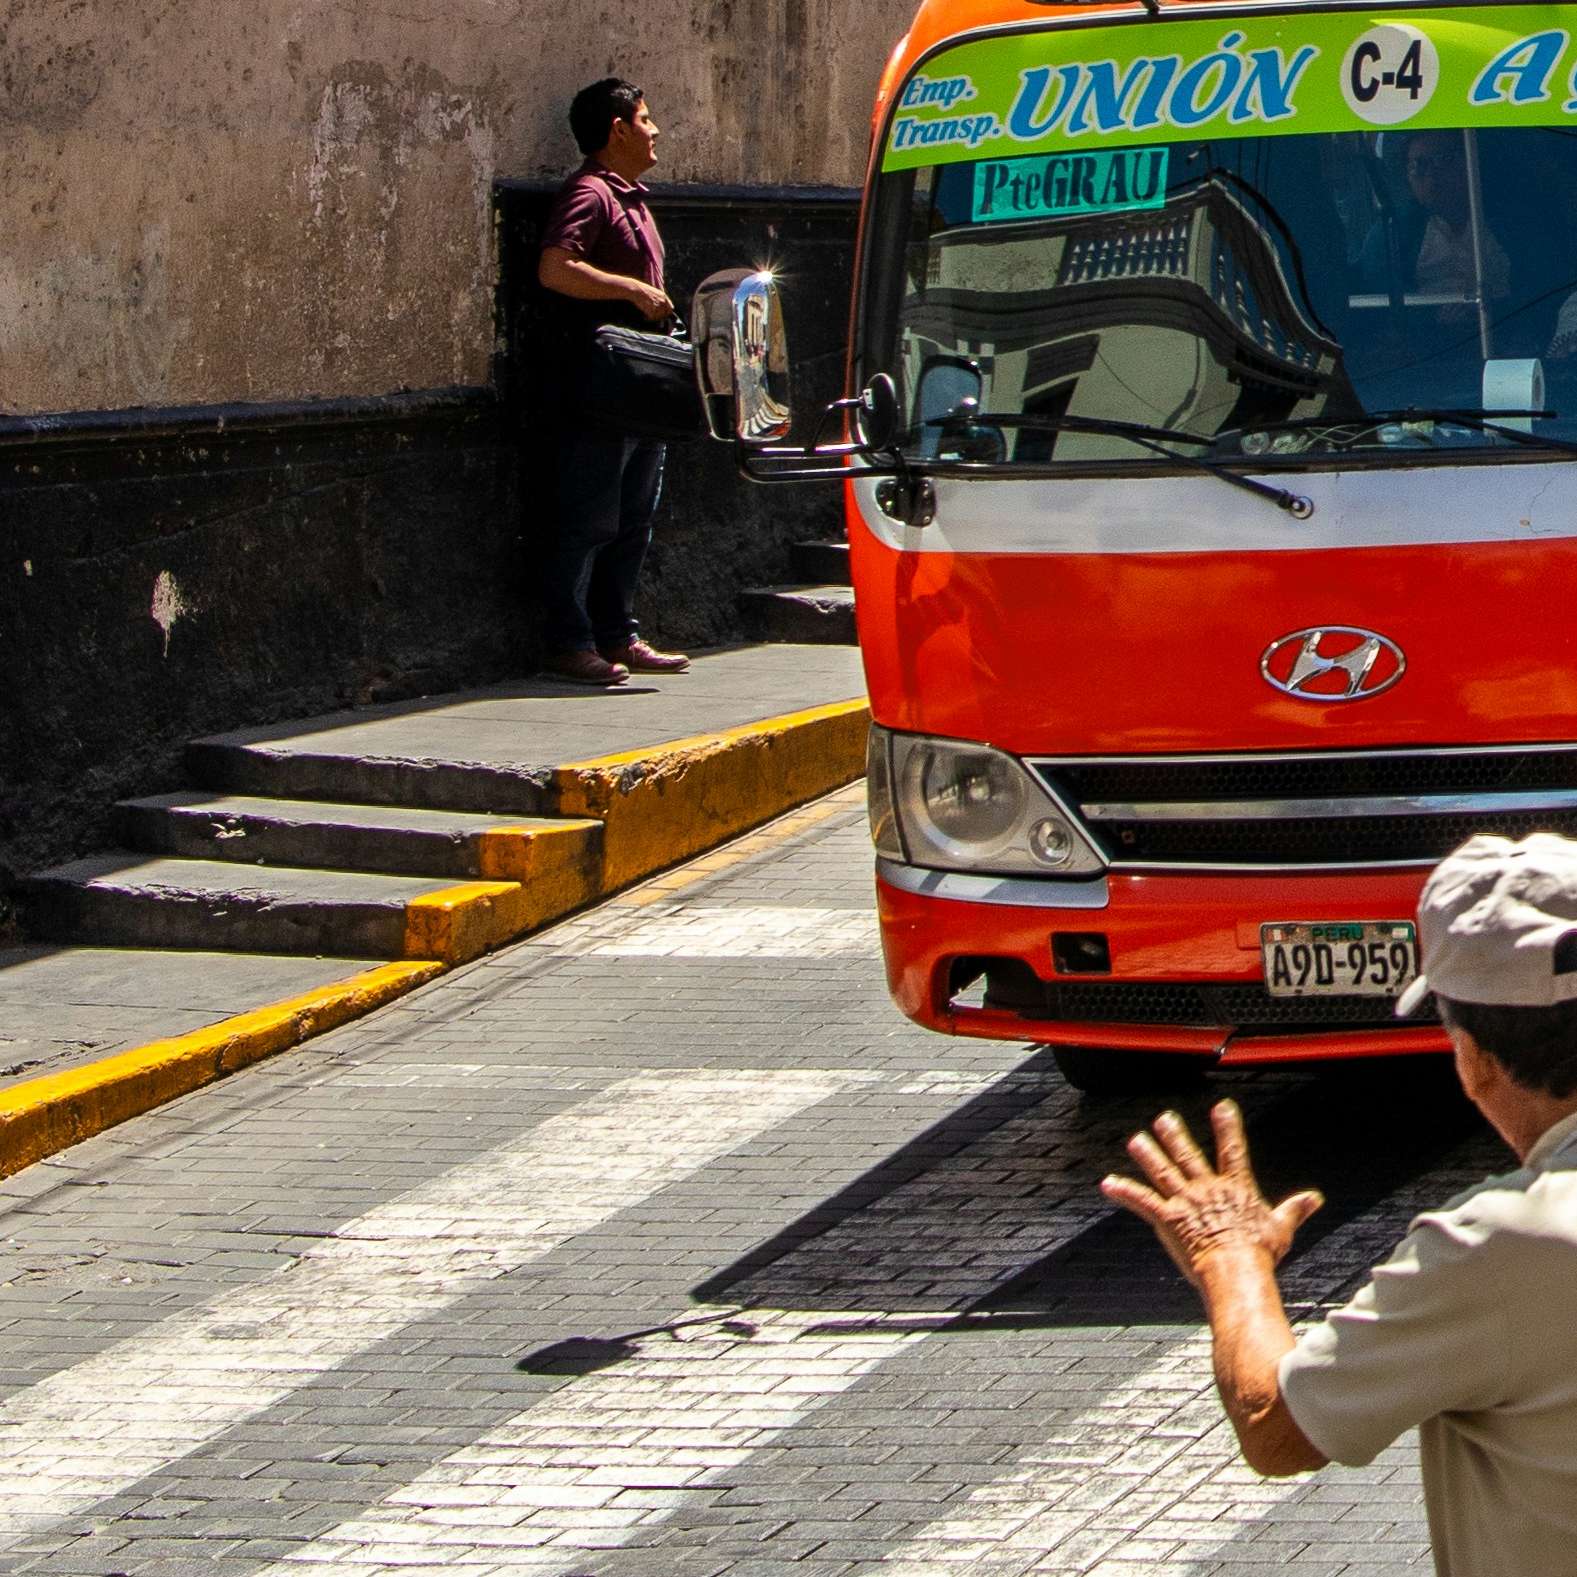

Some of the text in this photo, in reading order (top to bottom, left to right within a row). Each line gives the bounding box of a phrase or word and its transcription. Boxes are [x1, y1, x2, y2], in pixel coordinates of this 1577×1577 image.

[1011, 30, 1320, 140] UNIÓN
[1350, 41, 1423, 102] C-4
[902, 77, 975, 108] Emp.
[892, 113, 1000, 146] Transp.
[1312, 924, 1364, 942] PERU
[1272, 941, 1410, 988] A9D-959
